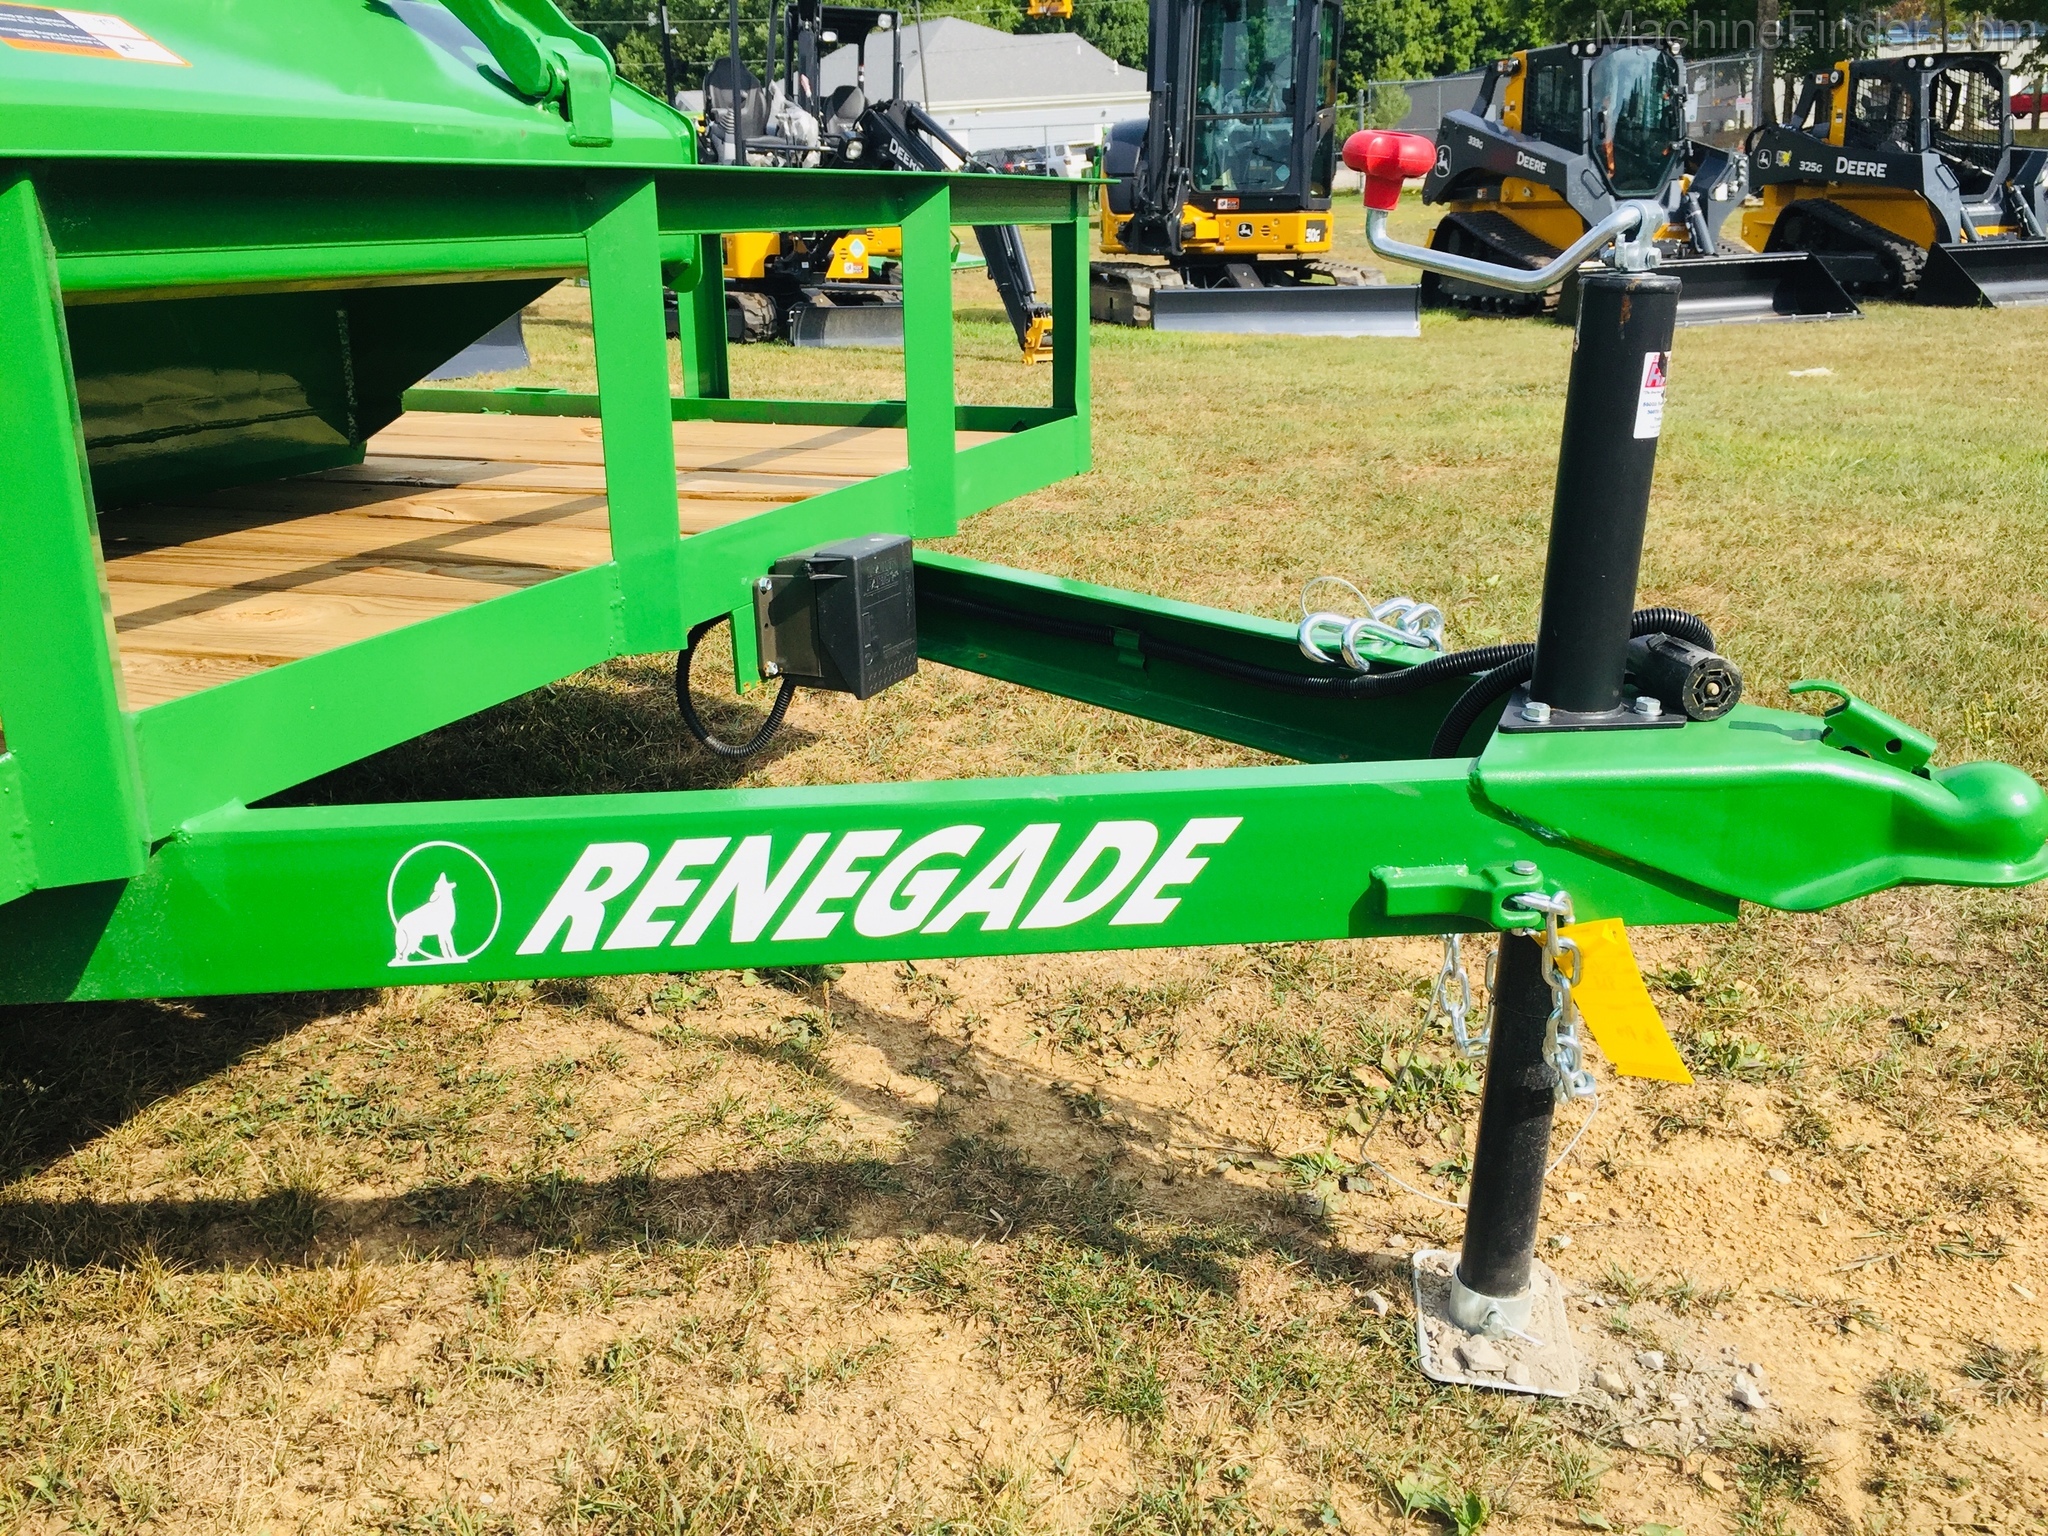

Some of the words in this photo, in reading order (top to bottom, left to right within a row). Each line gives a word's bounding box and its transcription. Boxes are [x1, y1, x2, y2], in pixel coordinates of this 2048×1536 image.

[1516, 151, 1548, 174] DEERE
[1799, 161, 1823, 173] 325G
[1835, 156, 1888, 178] DEERE
[1305, 228, 1321, 242] 50G
[515, 816, 1243, 955] RENEGADE
